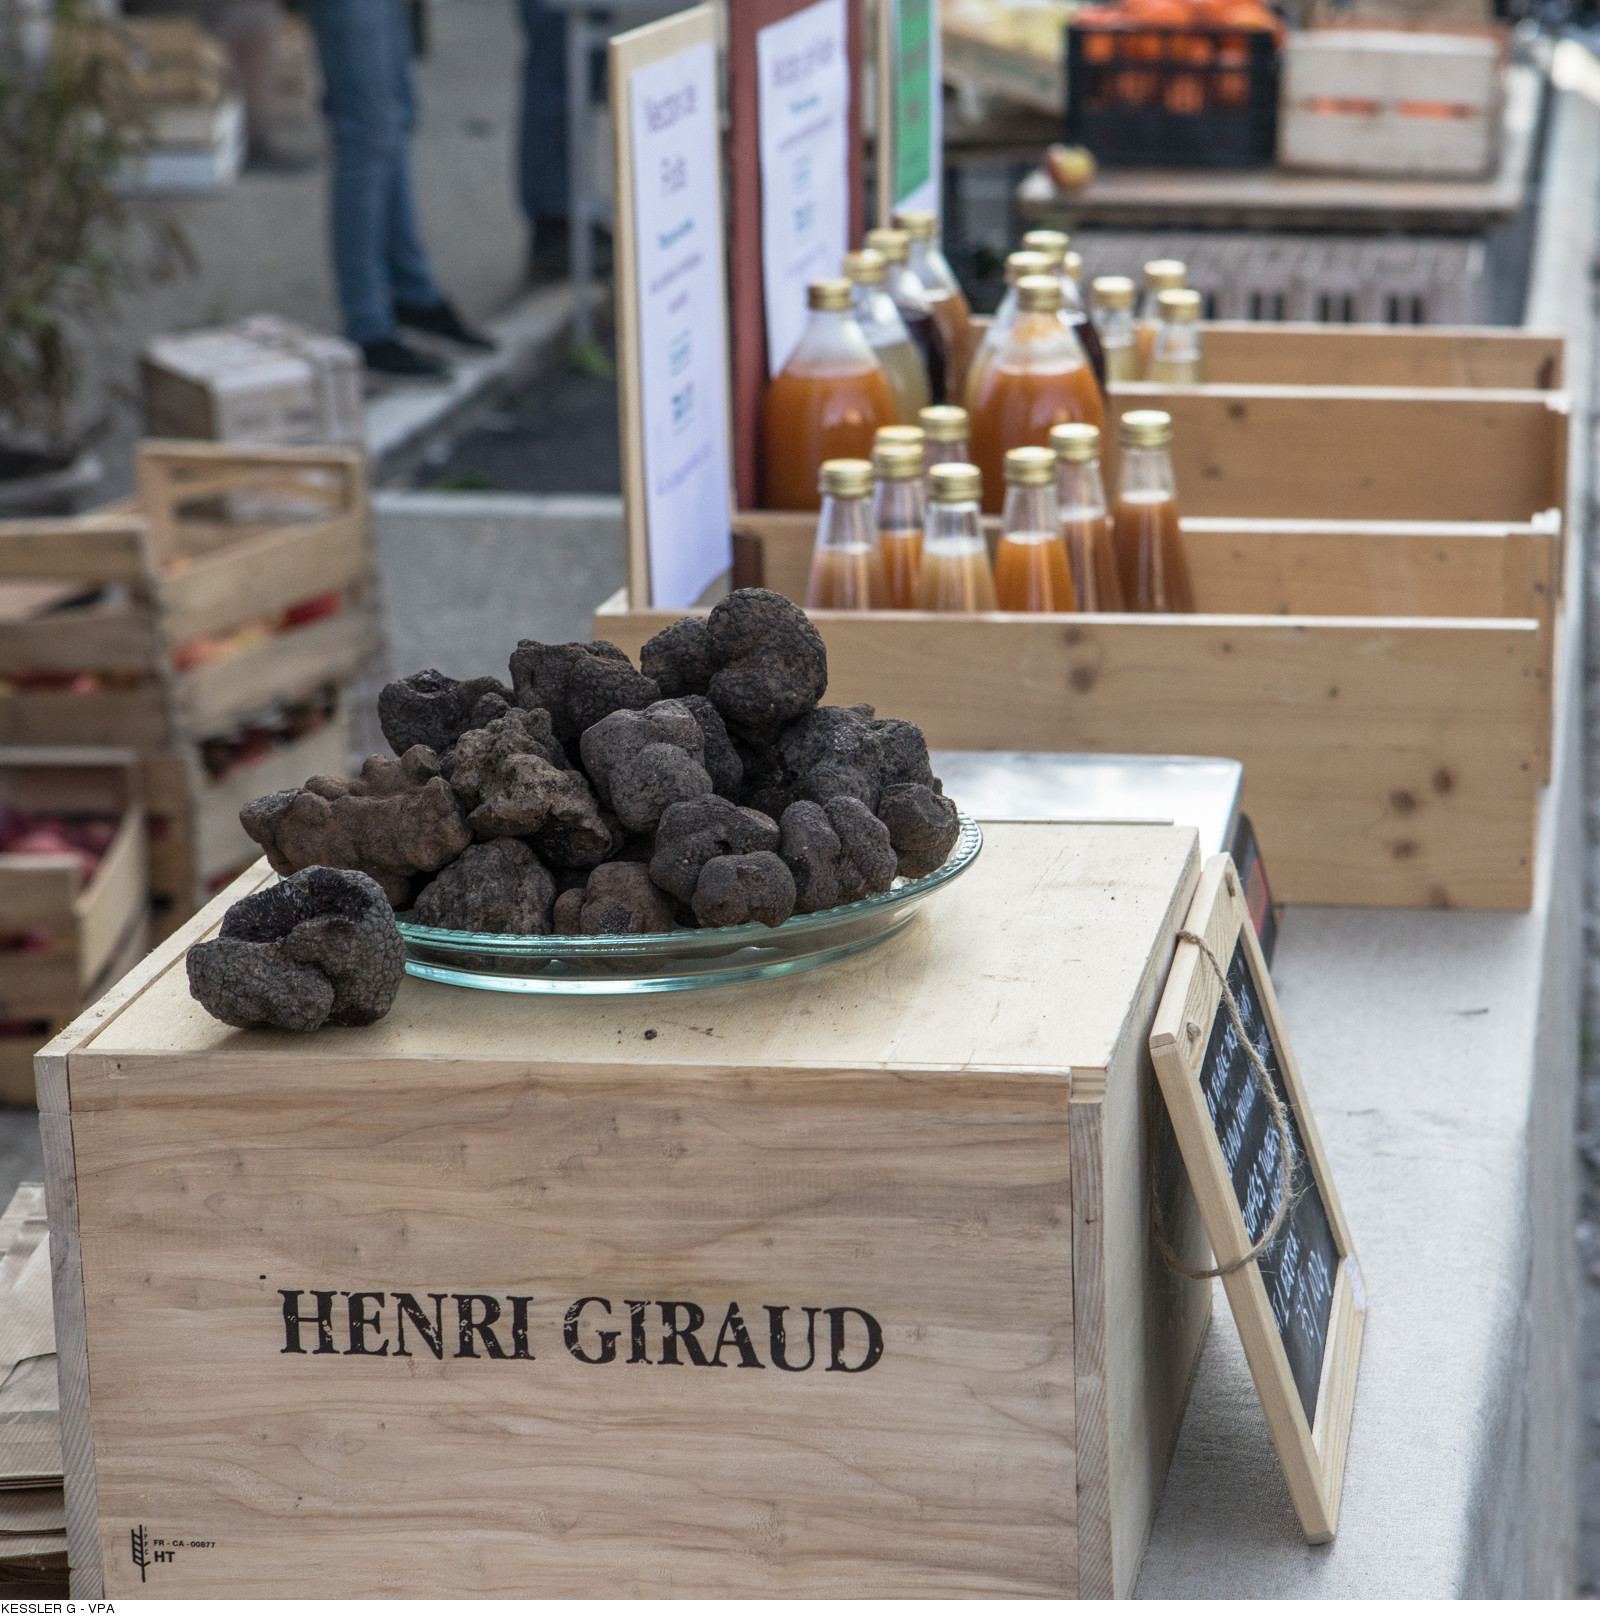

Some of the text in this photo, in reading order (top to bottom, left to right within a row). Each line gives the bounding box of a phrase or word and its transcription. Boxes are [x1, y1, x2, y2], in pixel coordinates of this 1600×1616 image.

[278, 1290, 884, 1373] HENRI GIRAUD
[153, 1539, 165, 1547] FR
[154, 1551, 176, 1563] HT
